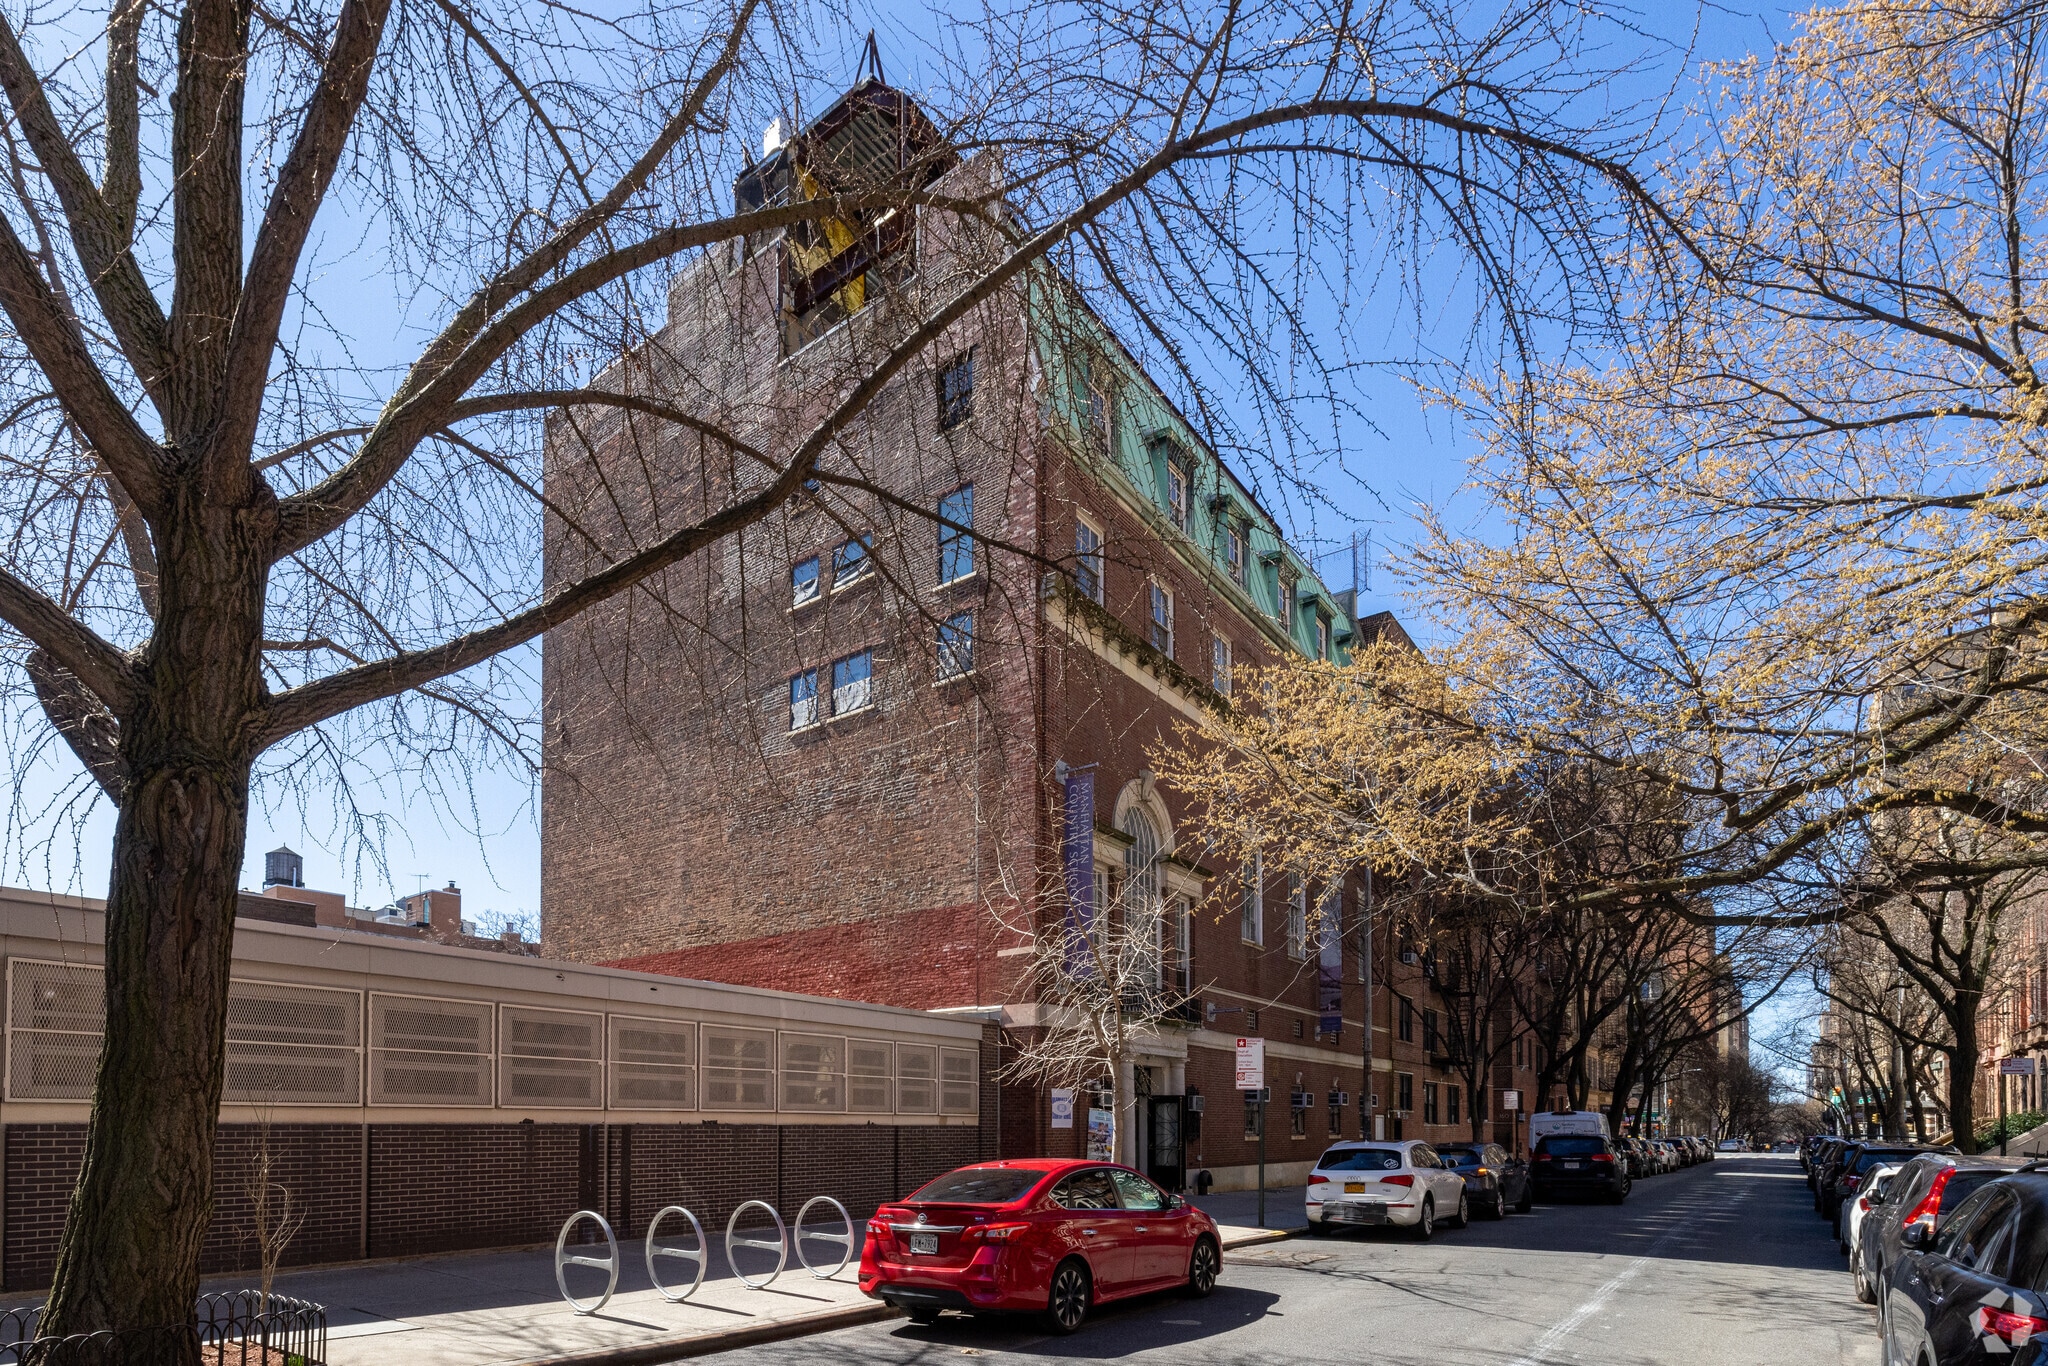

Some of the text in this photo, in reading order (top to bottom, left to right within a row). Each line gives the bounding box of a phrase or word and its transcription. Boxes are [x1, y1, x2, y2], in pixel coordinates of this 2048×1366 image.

[1069, 784, 1079, 908] COUNTRY SCHOO
[1080, 782, 1090, 864] MANHATTAN
